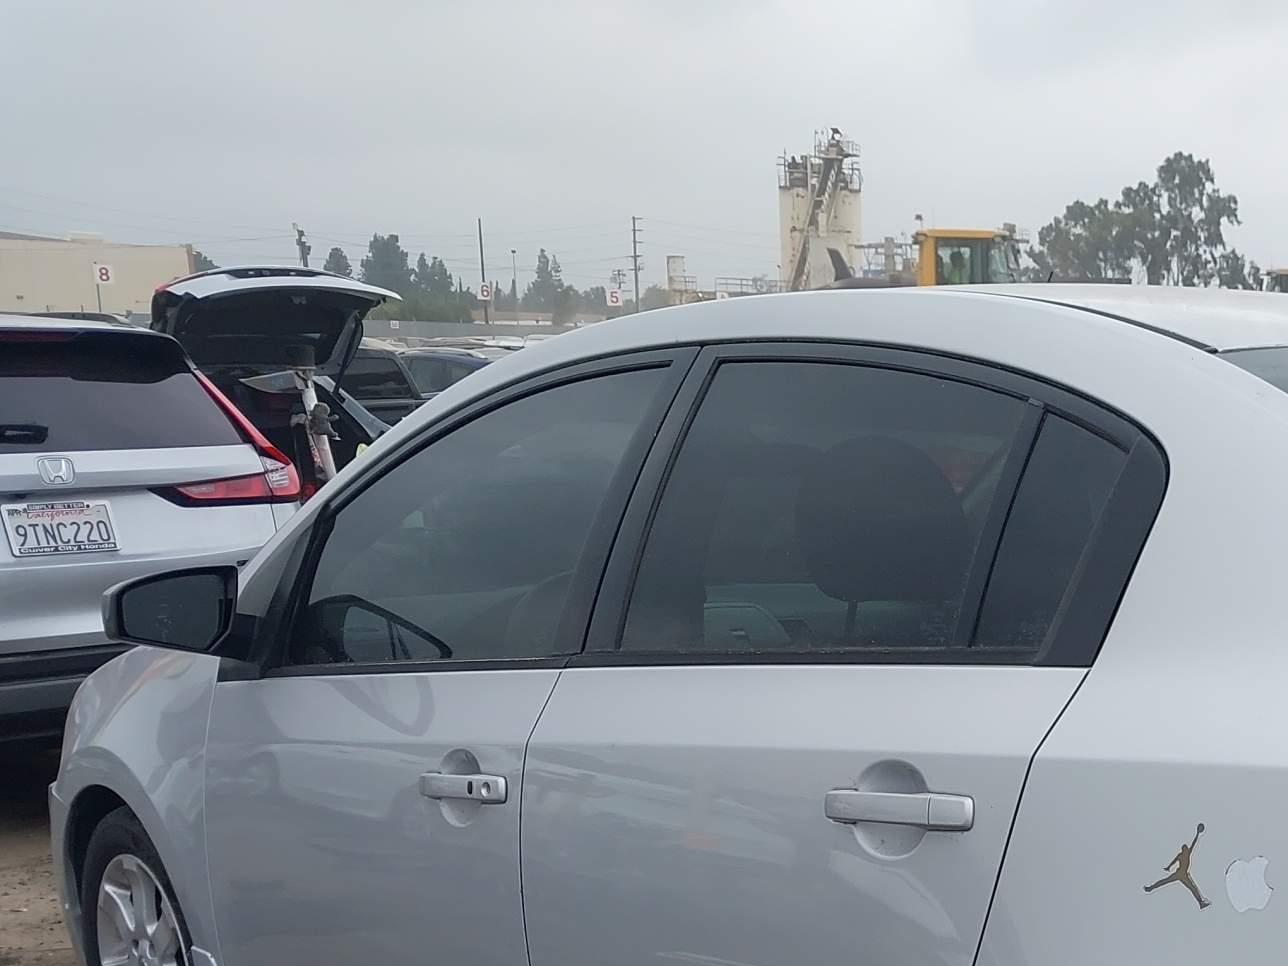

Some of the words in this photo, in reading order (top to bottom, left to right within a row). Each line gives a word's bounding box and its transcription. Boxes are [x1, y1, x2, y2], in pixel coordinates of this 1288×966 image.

[99, 267, 110, 281] 8
[481, 285, 490, 297] 6
[610, 291, 619, 304] 5
[15, 520, 111, 547] 9TNC220
